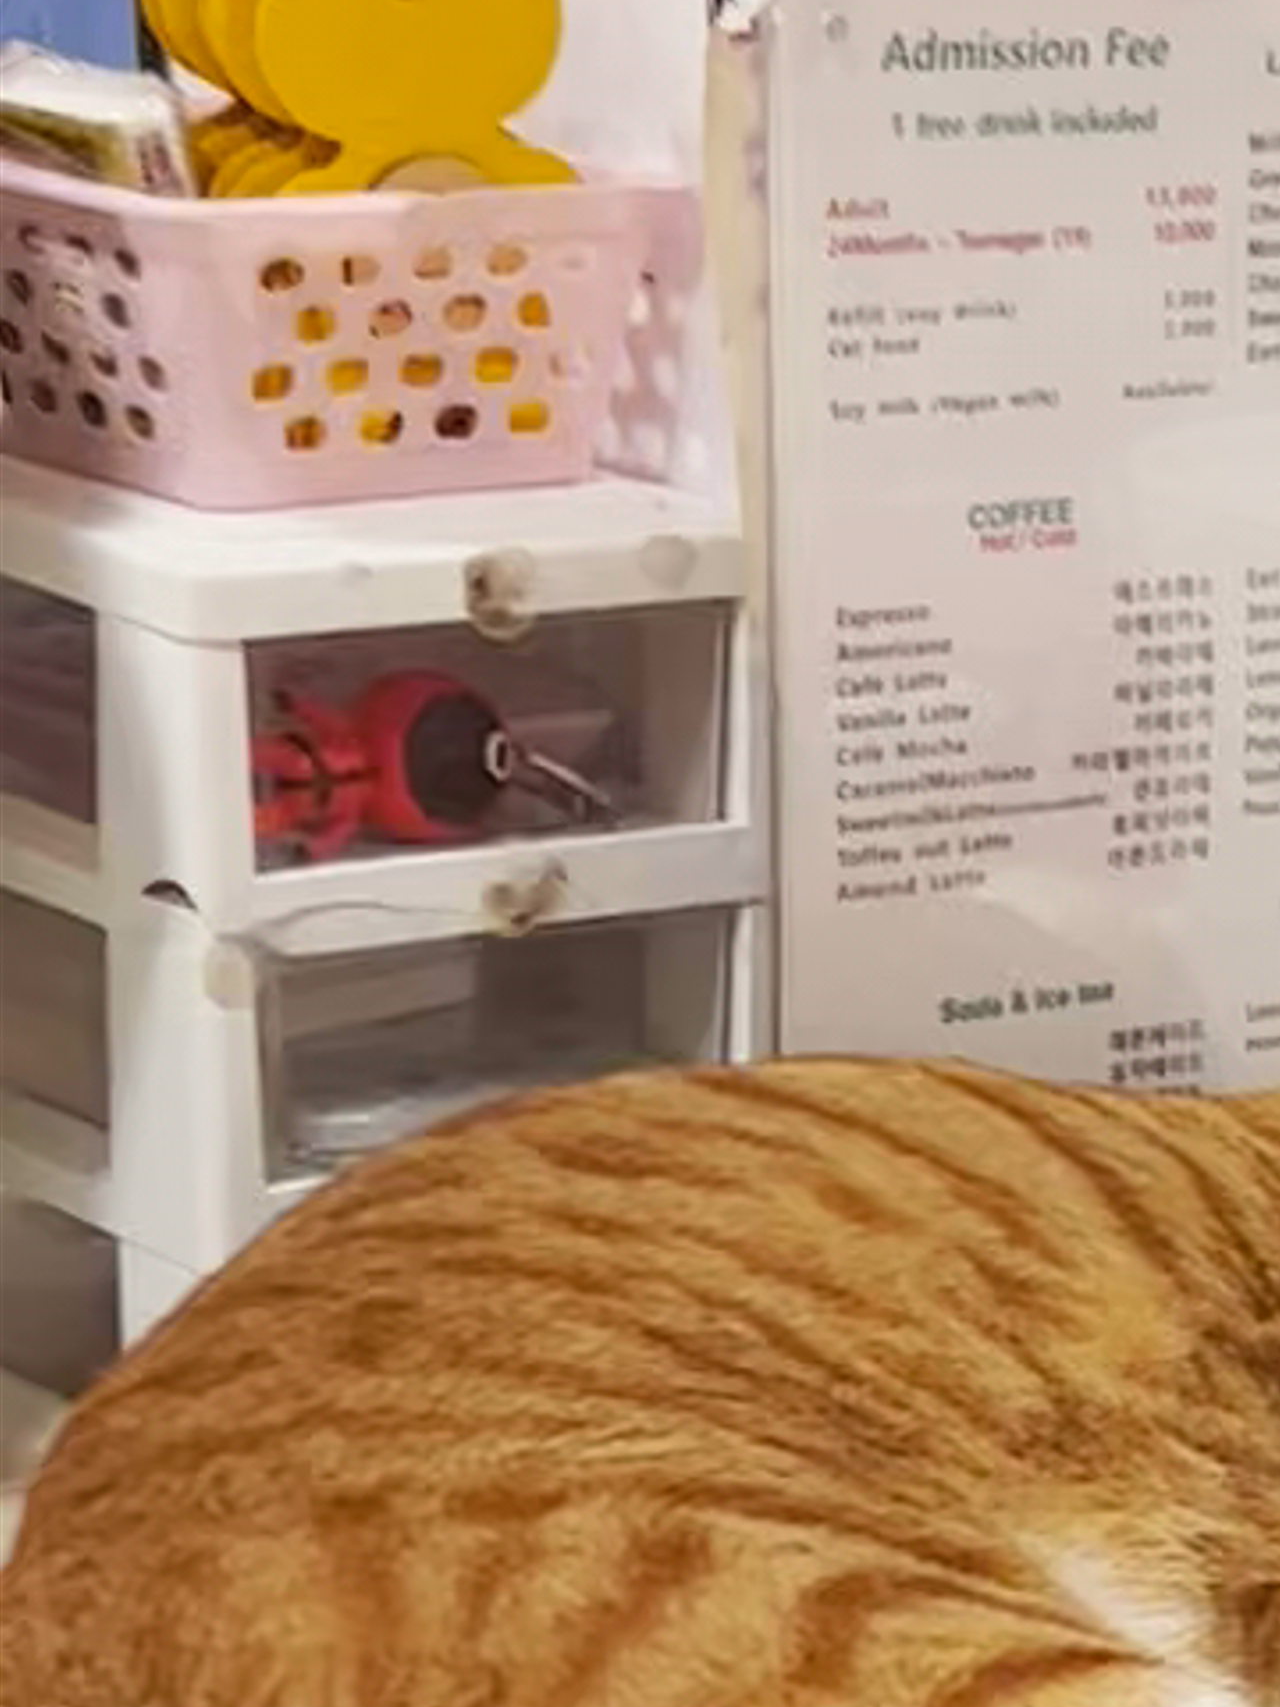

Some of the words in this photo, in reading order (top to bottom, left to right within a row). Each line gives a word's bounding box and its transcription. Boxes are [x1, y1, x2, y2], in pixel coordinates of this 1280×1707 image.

[881, 29, 1089, 71] Admission
[1105, 28, 1170, 67] Fee
[917, 113, 965, 138] free
[976, 106, 1042, 137] drink
[1051, 105, 1158, 134] included
[967, 497, 1075, 530] COFFEE
